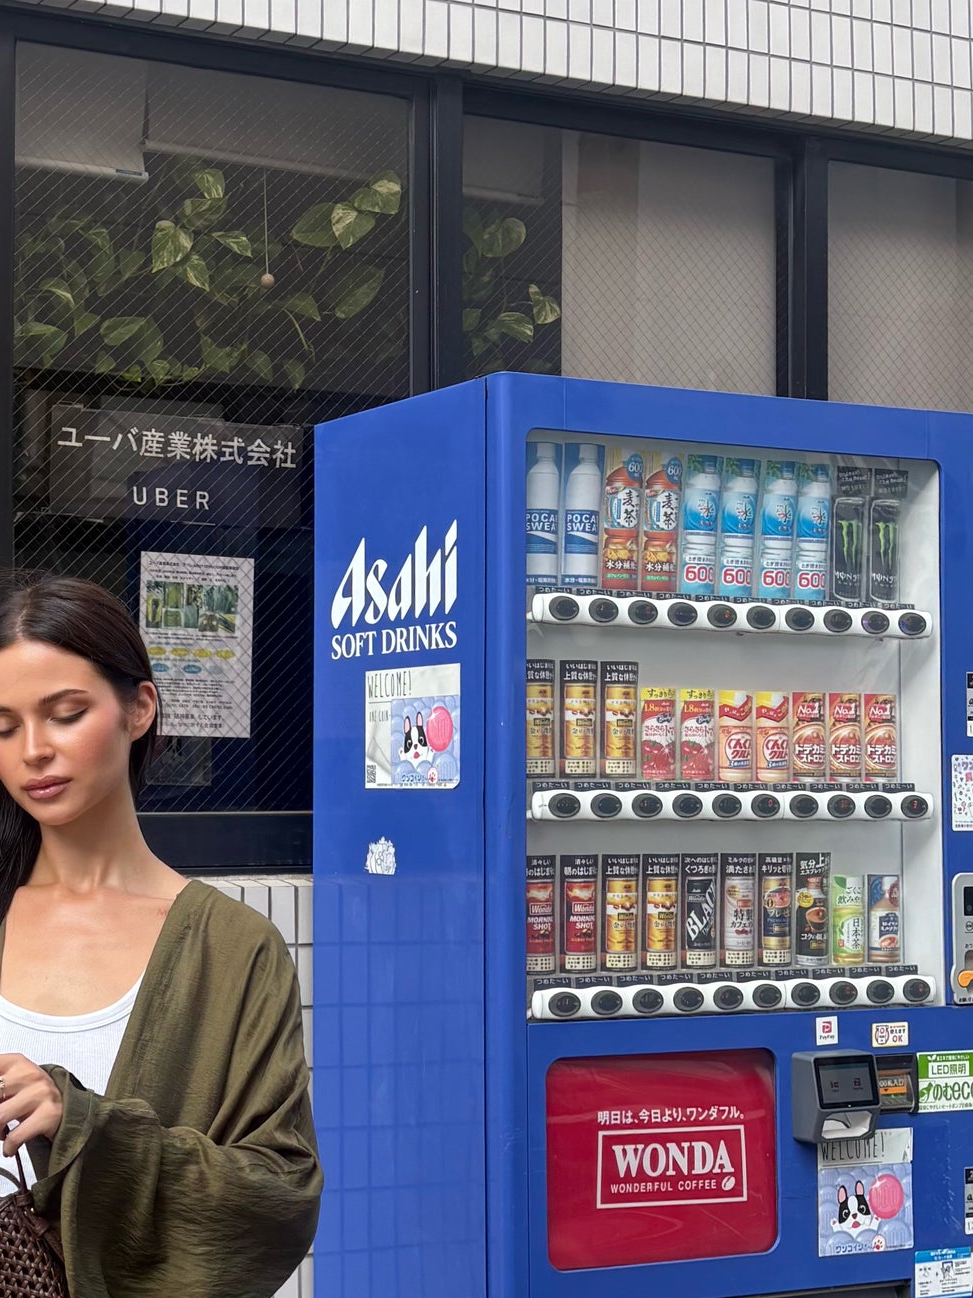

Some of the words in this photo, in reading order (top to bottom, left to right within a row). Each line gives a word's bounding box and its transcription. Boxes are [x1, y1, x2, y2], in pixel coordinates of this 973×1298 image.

[57, 426, 297, 469] ユーバ産業株式会社
[132, 486, 210, 510] UBER
[622, 490, 636, 527] 麦茶
[661, 492, 675, 530] 麦茶
[526, 513, 558, 522] POCA
[526, 522, 556, 532] SWEA
[567, 514, 598, 523] POCA
[567, 523, 597, 532] SWEA
[331, 519, 458, 630] Asahi
[331, 630, 377, 660] SOFT
[381, 621, 458, 656] DRINKS
[368, 670, 412, 698] WELCOME!
[686, 879, 716, 942] BLAC
[851, 918, 861, 950] 日本茶
[892, 1035, 903, 1043] OK
[931, 1064, 967, 1076] LED照明
[597, 1105, 745, 1126] 明日は、今日より、ワンダフル。
[611, 1139, 735, 1179] WONDA
[610, 1181, 673, 1194] WONDERFUL
[678, 1179, 717, 1191] COFFEE
